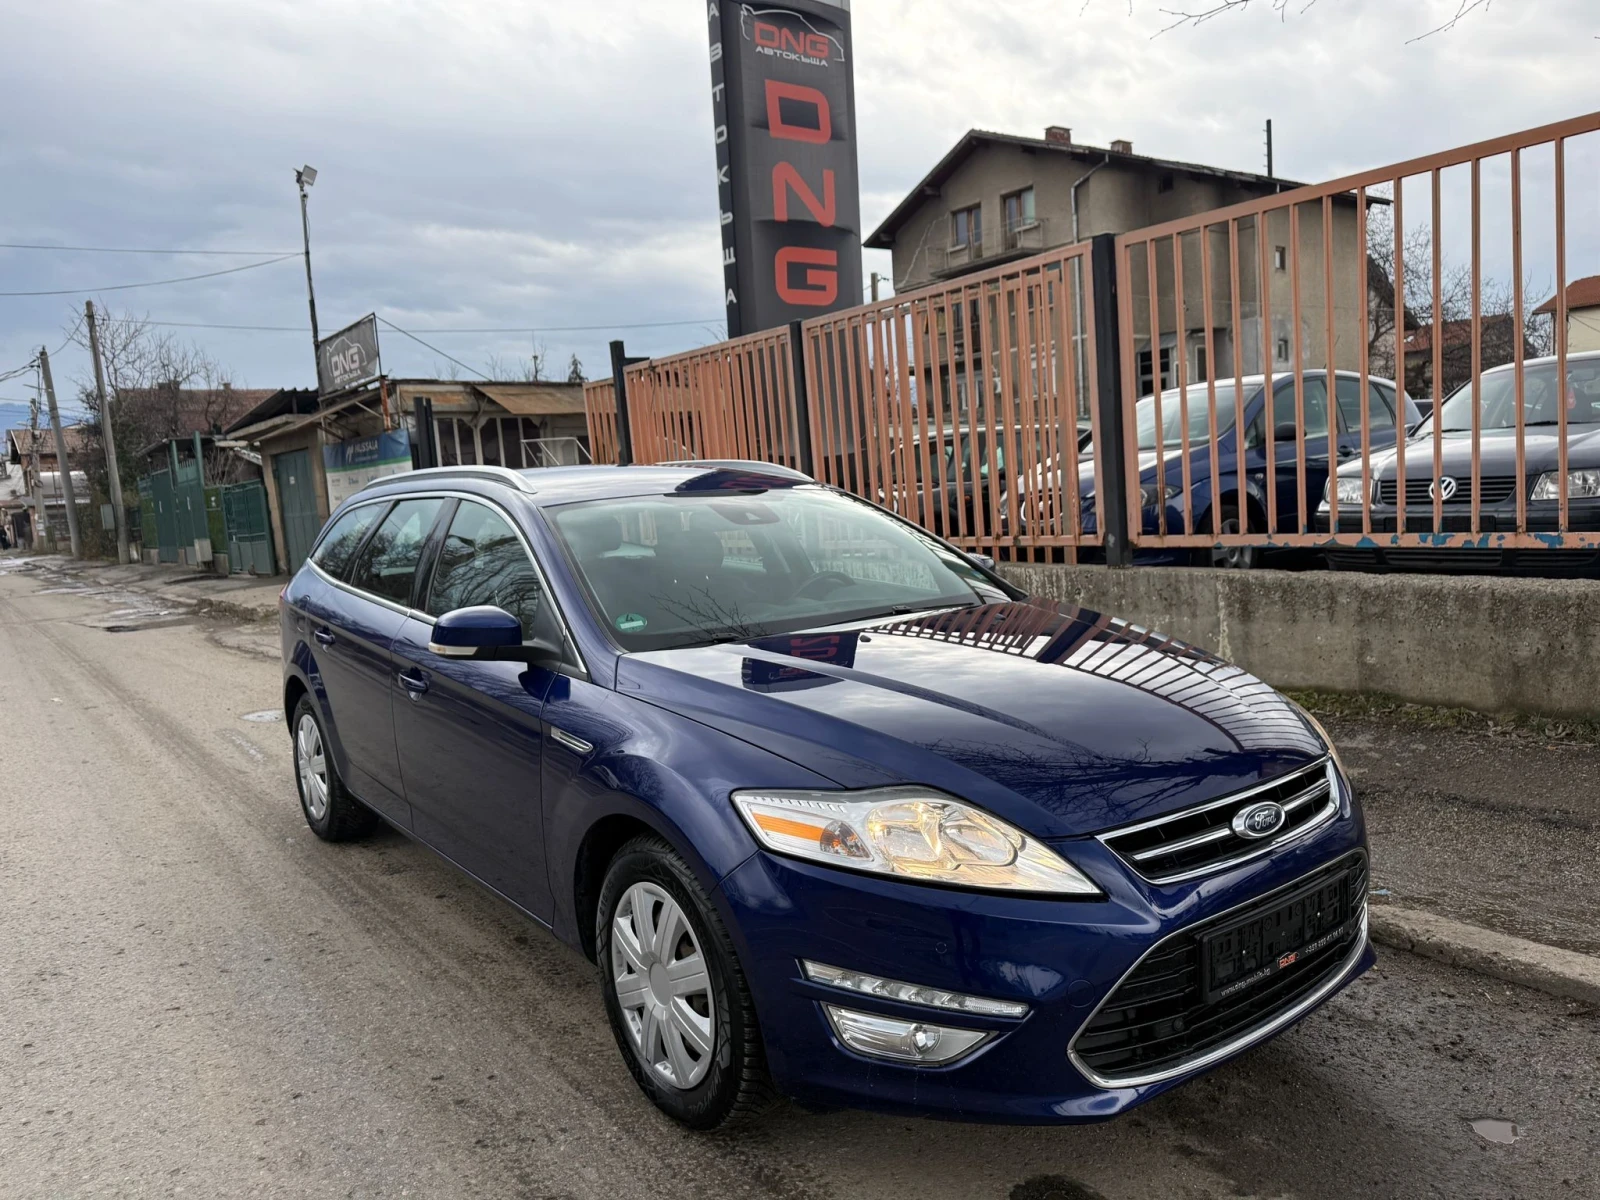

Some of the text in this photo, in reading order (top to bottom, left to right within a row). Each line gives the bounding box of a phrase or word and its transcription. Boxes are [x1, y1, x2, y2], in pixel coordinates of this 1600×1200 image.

[754, 21, 829, 58] DNG
[764, 79, 838, 306] DNG
[331, 346, 360, 377] DNG
[1255, 810, 1276, 829] Ford
